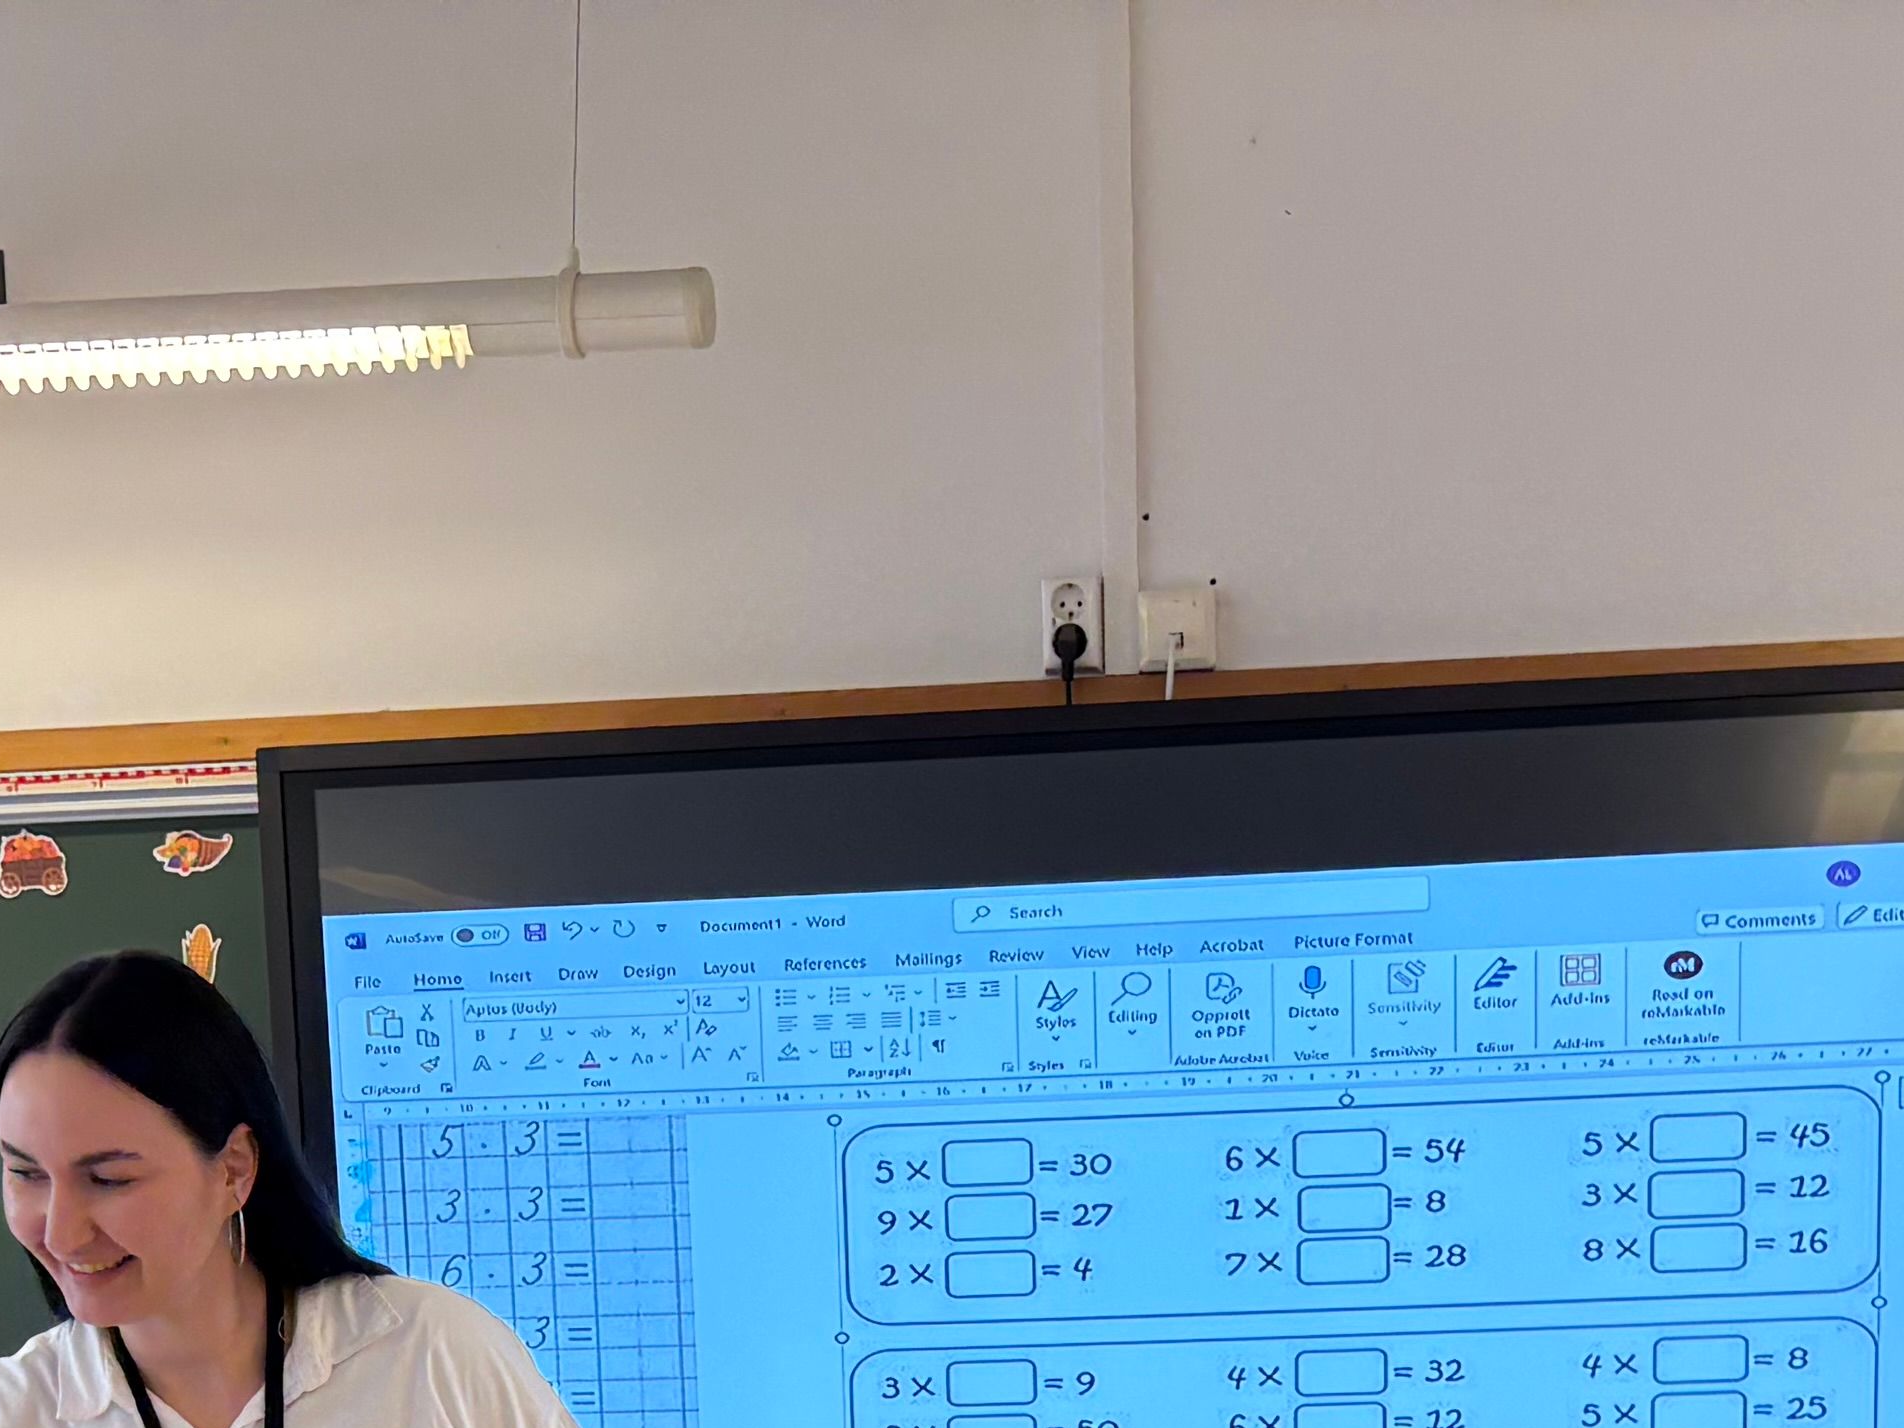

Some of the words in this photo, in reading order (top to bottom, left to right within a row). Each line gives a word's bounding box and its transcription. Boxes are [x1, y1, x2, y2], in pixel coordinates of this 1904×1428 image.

[699, 918, 782, 934] Document1
[805, 914, 847, 929] Word
[1008, 904, 1064, 920] Search
[1724, 912, 1817, 930] Comments
[354, 975, 382, 990] File
[413, 972, 464, 988] Home
[489, 969, 533, 984] Insert
[558, 966, 599, 982] Draw
[622, 964, 677, 982] Design
[703, 959, 757, 978] Layout
[784, 956, 868, 973] References
[895, 951, 964, 971] Mailings
[988, 949, 1045, 965] Review
[1071, 944, 1111, 960] View
[1135, 941, 1174, 959] Help
[1199, 937, 1265, 955] Acrobat
[1293, 933, 1351, 951] Picture
[1354, 931, 1414, 948] Format
[1472, 995, 1518, 1011] Editor
[1550, 991, 1611, 1007] Add-ins
[1035, 1015, 1077, 1032] Styles
[1107, 1009, 1159, 1027] Editing
[1216, 1025, 1247, 1039] PDF
[360, 1083, 421, 1098] Clipboard
[582, 1076, 612, 1089] Font
[433, 1123, 465, 1158] 5
[515, 1121, 541, 1157] 3
[1225, 1146, 1245, 1172] 6
[1424, 1138, 1467, 1164] 54
[1582, 1132, 1604, 1158] 5
[1790, 1122, 1832, 1148] 45
[876, 1159, 895, 1185] 5
[1070, 1152, 1113, 1177] 30
[435, 1189, 462, 1223] 3
[518, 1186, 544, 1221] 3
[1225, 1197, 1245, 1221] 1
[1426, 1189, 1447, 1213] 8
[1581, 1183, 1603, 1208] 3
[1789, 1174, 1831, 1199] 12
[877, 1210, 897, 1235] 9
[1072, 1203, 1114, 1228] 27
[1226, 1252, 1247, 1277] 7
[1424, 1243, 1468, 1268] 28
[1582, 1237, 1604, 1264] 8
[1788, 1228, 1830, 1254] 16
[441, 1254, 466, 1288] 6
[521, 1252, 547, 1286] 3
[879, 1264, 899, 1287] 2
[1073, 1256, 1094, 1281] 4
[525, 1316, 551, 1350] 3
[1227, 1364, 1247, 1390] 4
[1424, 1358, 1467, 1384] 32
[1581, 1352, 1603, 1378] 4
[1788, 1347, 1810, 1372] 8
[881, 1376, 901, 1400] 3
[1076, 1371, 1097, 1396] 9
[1581, 1402, 1602, 1428] 5
[1786, 1395, 1828, 1421] 25
